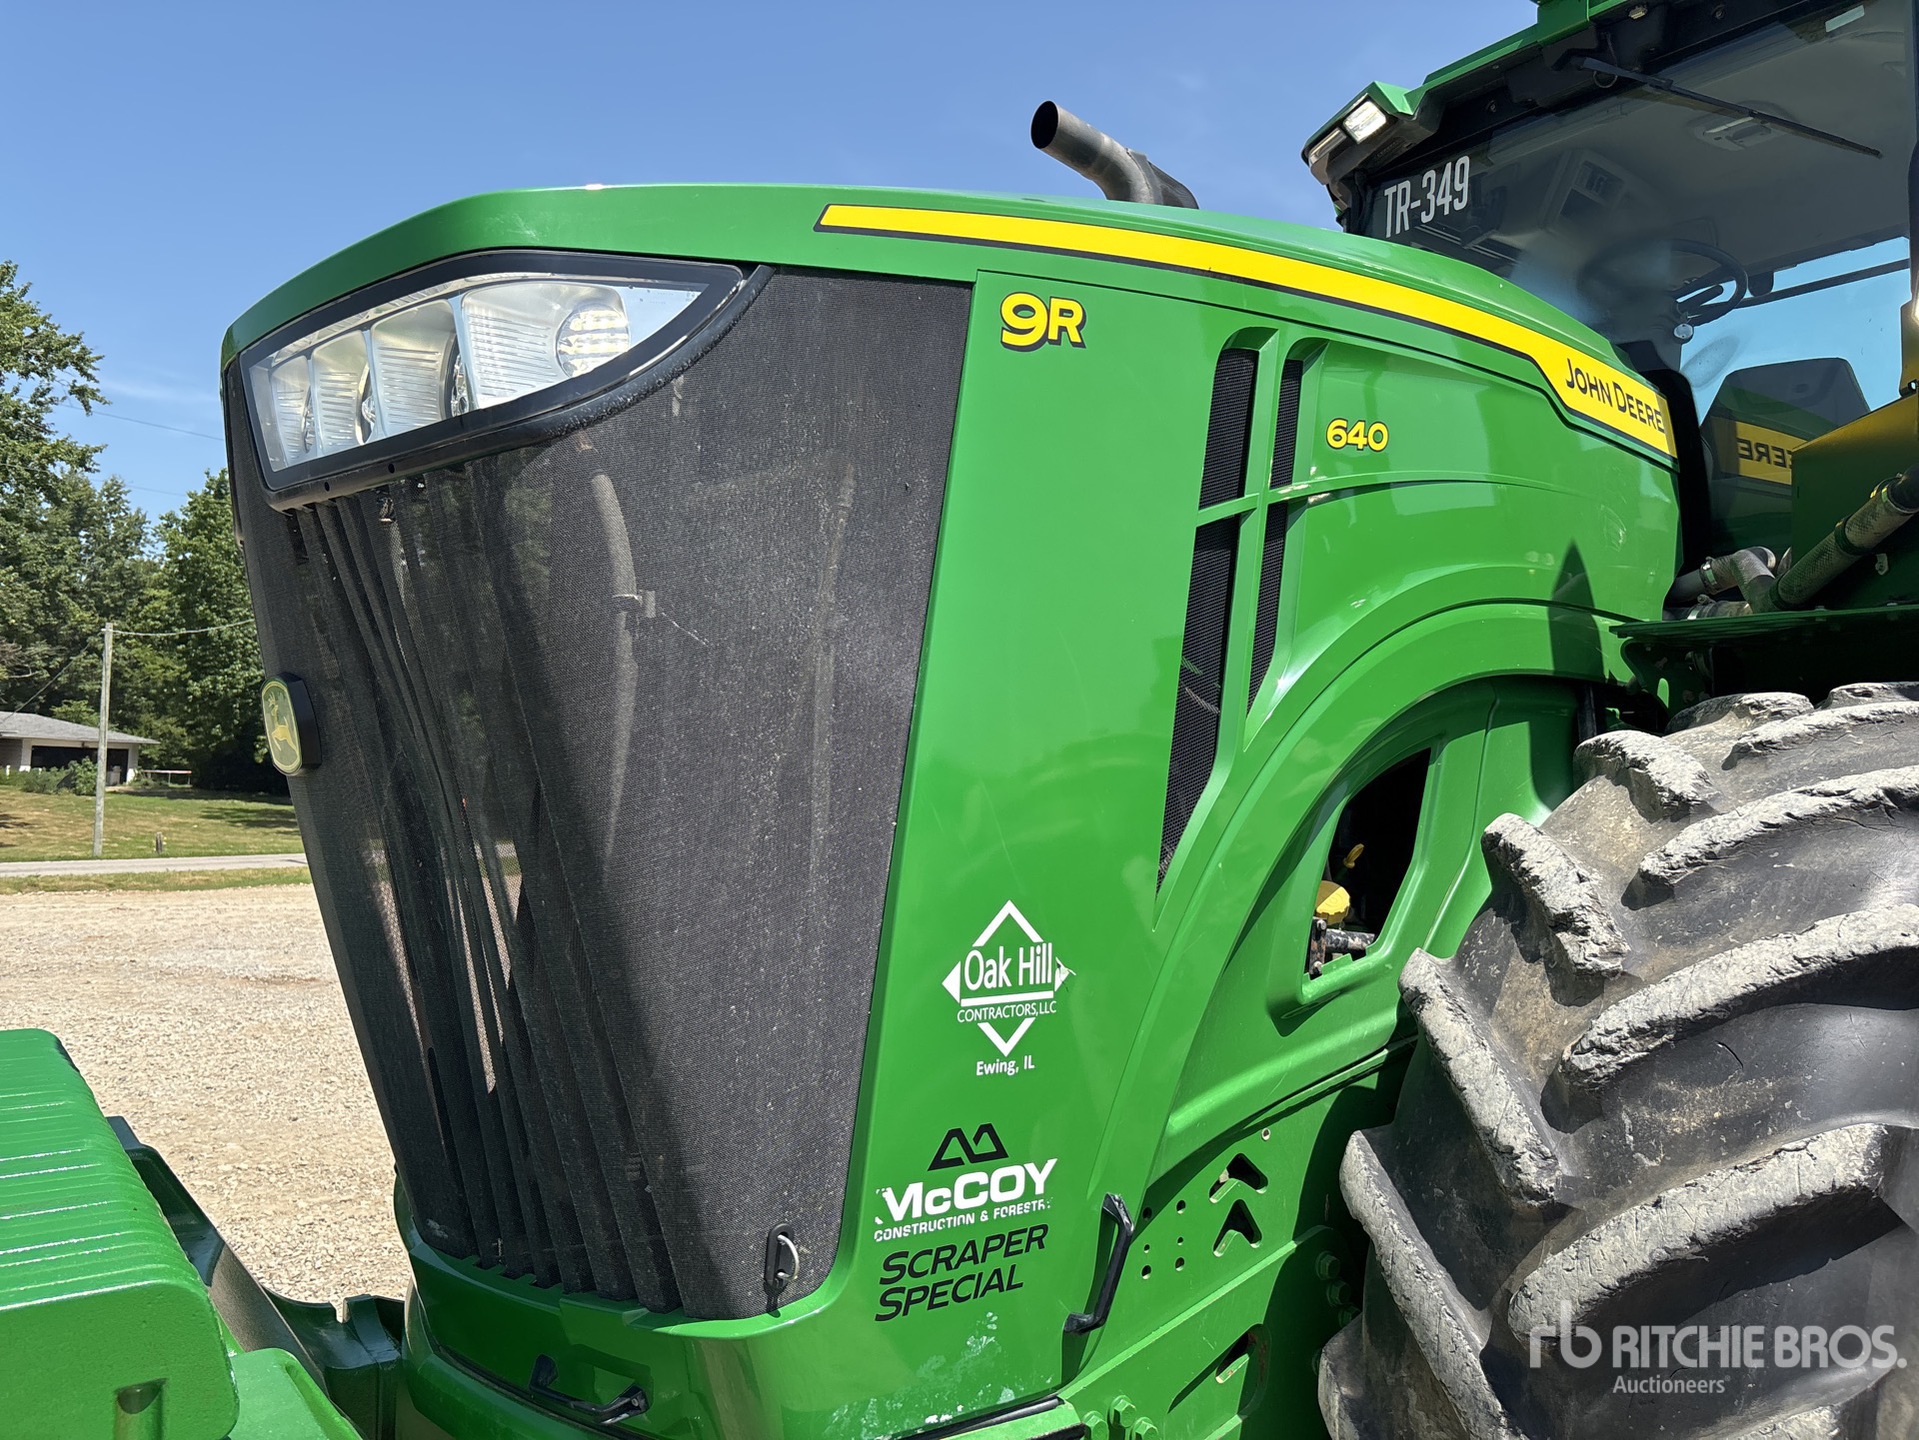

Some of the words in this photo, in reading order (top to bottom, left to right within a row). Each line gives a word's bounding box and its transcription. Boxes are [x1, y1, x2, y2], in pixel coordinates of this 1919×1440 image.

[1384, 155, 1470, 239] TR-349
[1000, 291, 1087, 353] 9R
[1565, 358, 1613, 408] JOHN
[1612, 381, 1666, 434] DEERE
[1326, 417, 1389, 452] 640
[964, 945, 1013, 991] Oak
[1018, 942, 1053, 986] Hill
[976, 1058, 1020, 1076] Ewing,
[1023, 1054, 1036, 1070] IL
[874, 1157, 1058, 1226] McCOY
[873, 1213, 976, 1243] CONSTRUCTION
[979, 1209, 989, 1222] &
[878, 1223, 1049, 1286] SCRAPER
[874, 1263, 1025, 1322] SPECIAL
